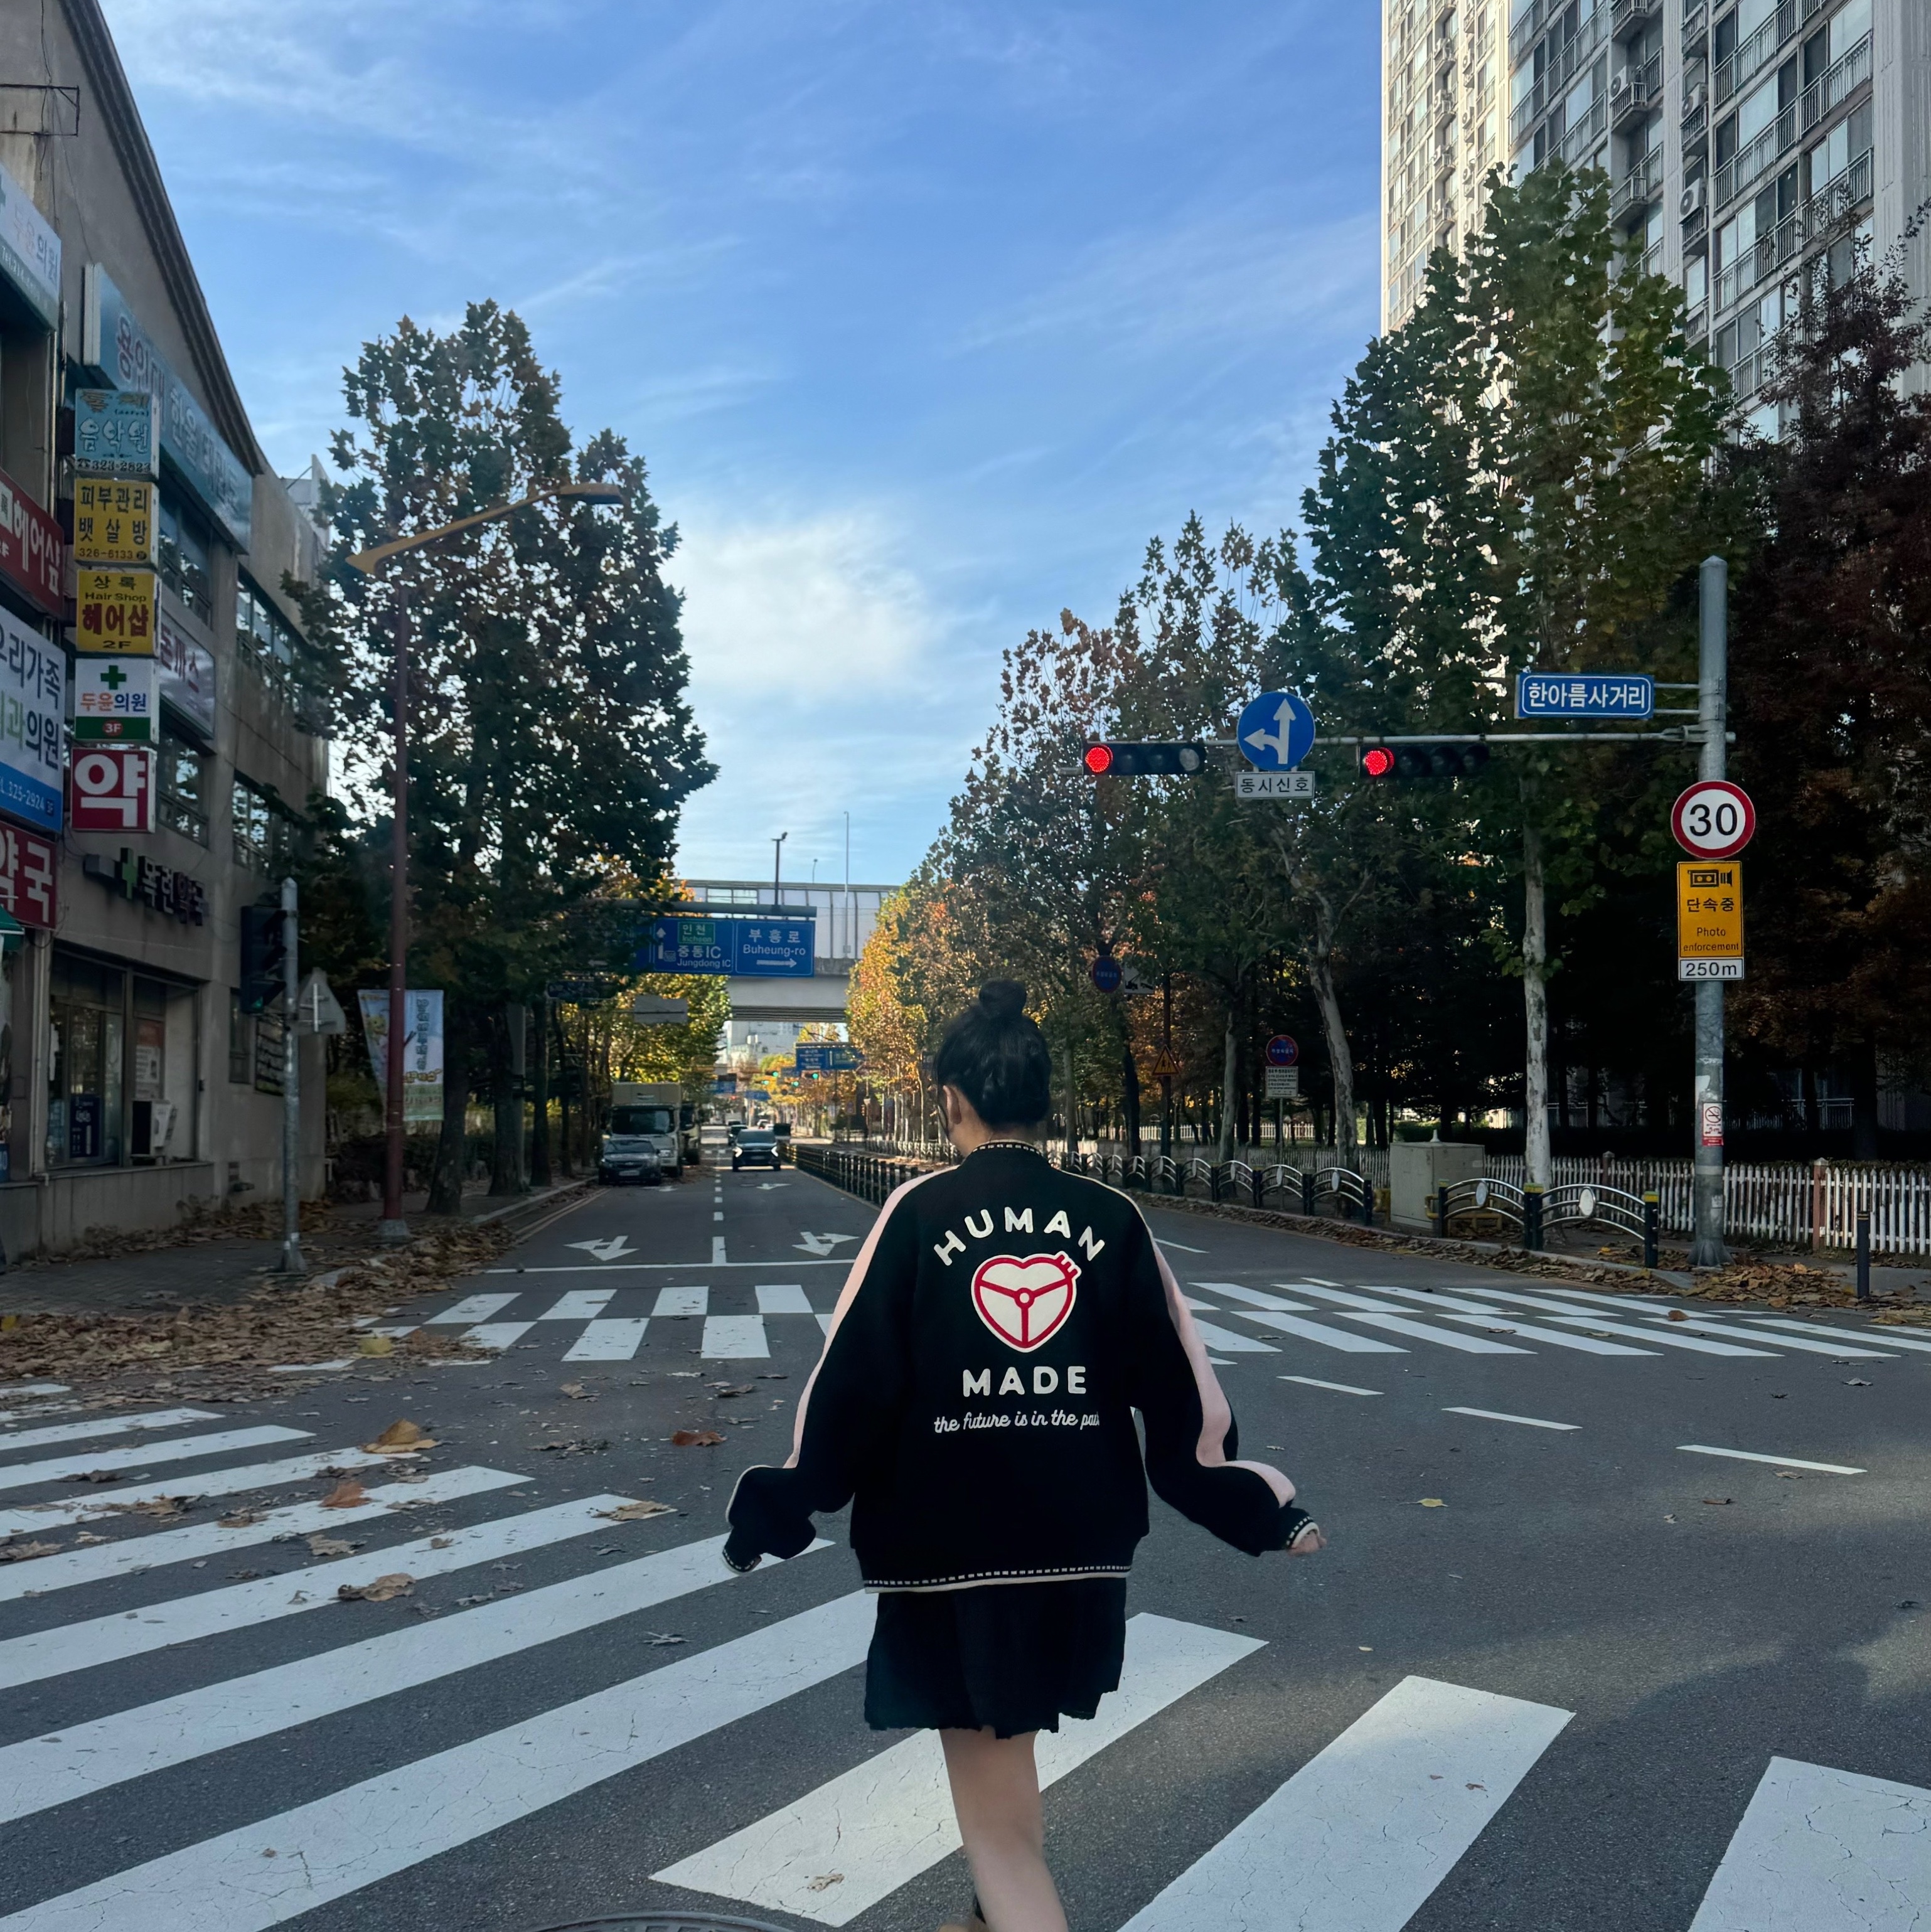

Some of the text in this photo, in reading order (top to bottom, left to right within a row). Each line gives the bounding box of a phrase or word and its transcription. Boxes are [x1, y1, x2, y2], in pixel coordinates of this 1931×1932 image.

[79, 417, 148, 454] 음악원
[80, 484, 147, 514] 피부관리
[14, 500, 61, 597] 헤어샵
[79, 547, 134, 560] 326-6133
[85, 592, 147, 603] Hair Shop
[82, 603, 149, 637] 헤어샵
[102, 640, 132, 649] 2F
[80, 693, 146, 712] 두윤의원
[1528, 682, 1645, 708] 한아름사거리
[105, 723, 122, 733] 3F
[74, 753, 146, 828] 약
[1240, 777, 1309, 793] 동시신호
[1689, 803, 1738, 837] 30
[0, 827, 53, 924] 약국
[1686, 897, 1735, 912] 단속중
[682, 924, 706, 936] 인천
[748, 928, 800, 943] 부흥로
[1696, 927, 1726, 937] Photo
[742, 944, 806, 958] Buheung-ro
[1683, 943, 1739, 952] enforcement
[677, 959, 731, 969] Jungdong IC
[1686, 962, 1737, 976] 250m
[933, 1206, 1105, 1266] HUMAN
[963, 1365, 1086, 1397] MADE
[934, 1416, 960, 1433] the
[963, 1411, 1011, 1430] future
[1014, 1411, 1028, 1426] is
[1030, 1411, 1048, 1426] in
[1051, 1409, 1078, 1426] the
